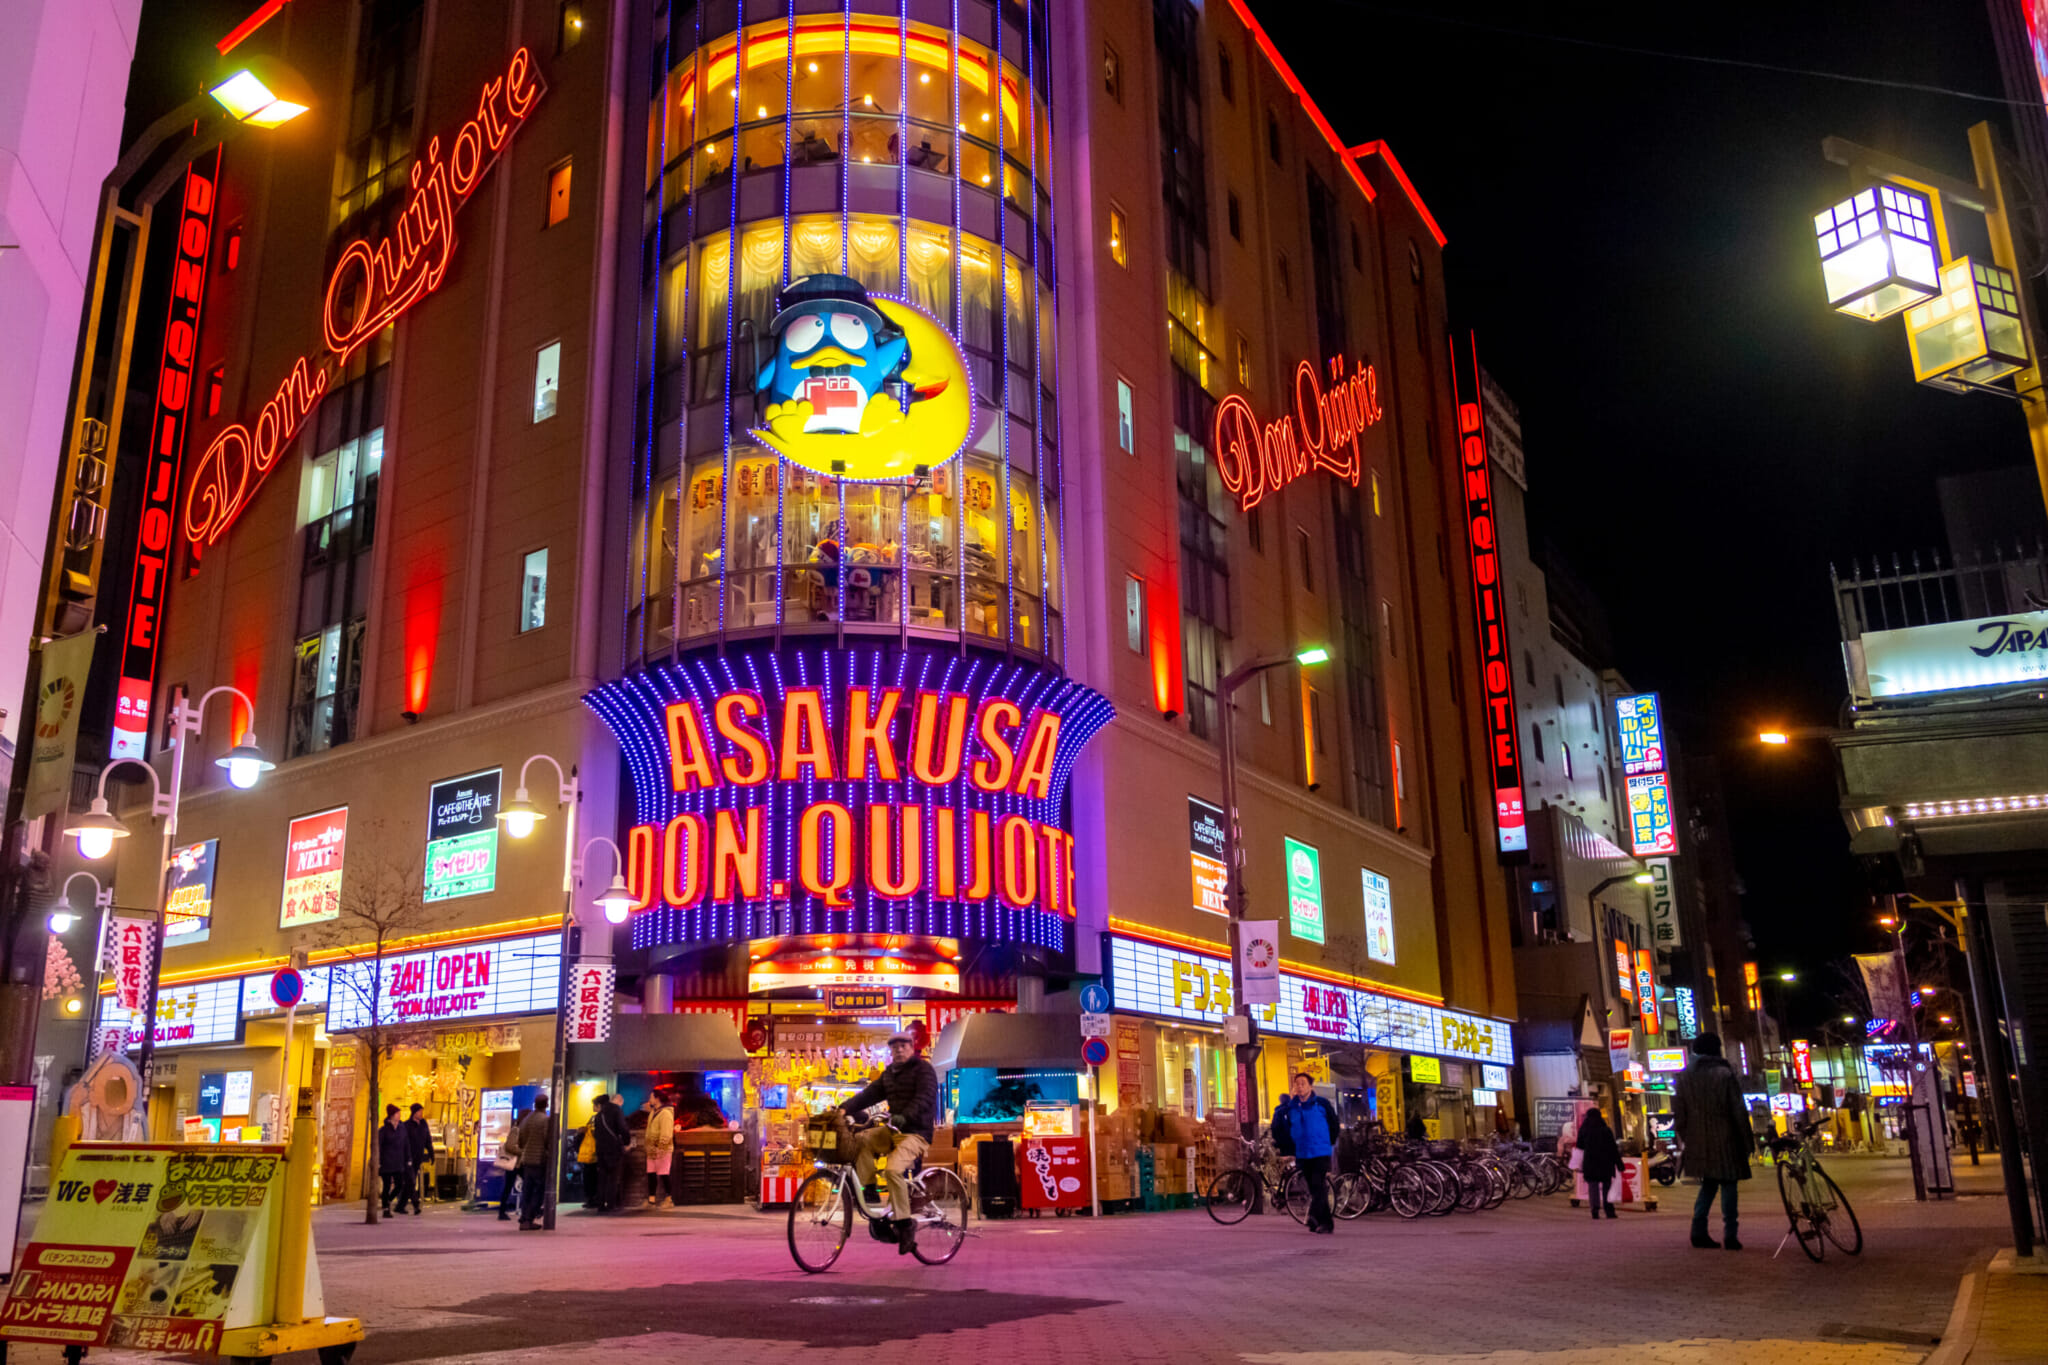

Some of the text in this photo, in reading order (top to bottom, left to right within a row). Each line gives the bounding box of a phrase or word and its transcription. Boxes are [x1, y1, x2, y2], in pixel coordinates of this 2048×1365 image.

[1636, 698, 1658, 748] ネット
[665, 685, 1062, 800] ASAKUSA
[1623, 718, 1643, 761] ルーム
[1650, 787, 1668, 828] まんが
[296, 846, 334, 872] NEXT
[433, 850, 490, 880] サイゼリヤ
[285, 889, 339, 919] 食べ放題
[122, 923, 145, 1010] 六区花道
[389, 950, 491, 997] 24H OPEN
[577, 968, 603, 1040] 六区花道
[56, 1180, 154, 1204] We 浅草
[250, 1187, 265, 1201] 24
[35, 1280, 116, 1303] PANDORA
[4, 1301, 108, 1326] パンドラ浅草店
[135, 1330, 194, 1350] 左手ビル
